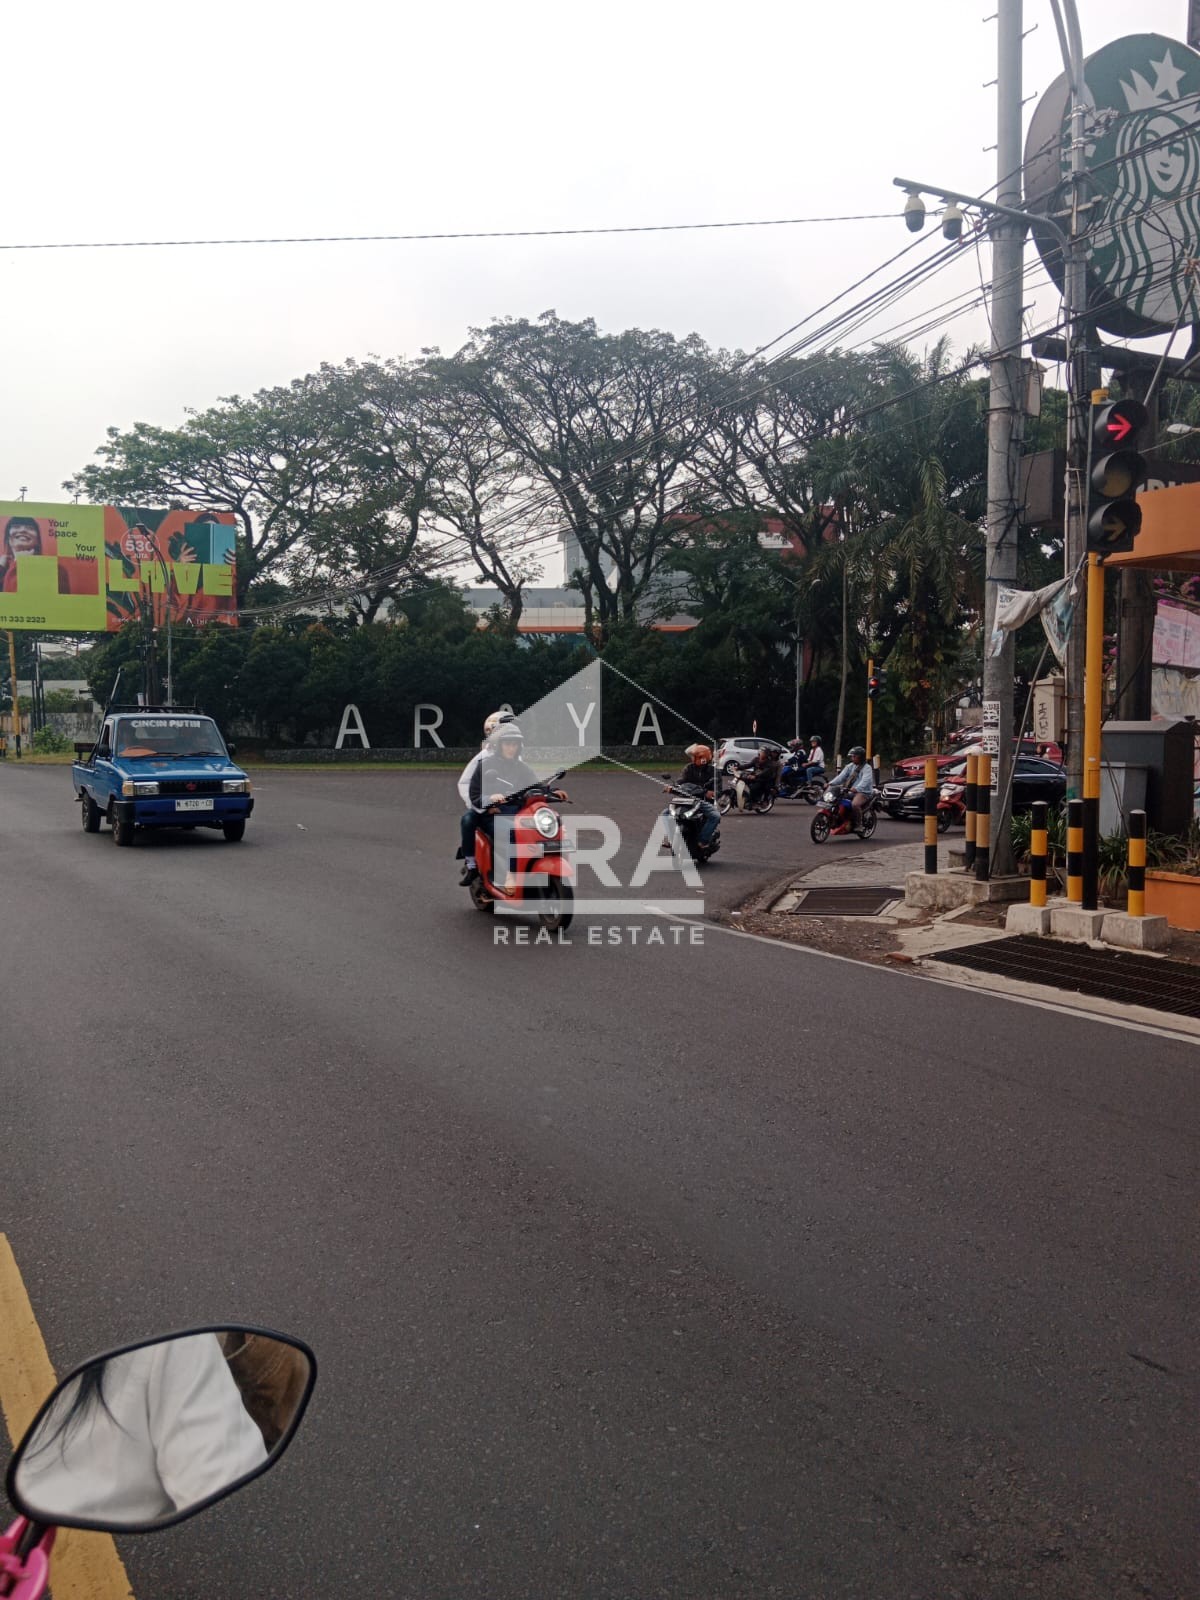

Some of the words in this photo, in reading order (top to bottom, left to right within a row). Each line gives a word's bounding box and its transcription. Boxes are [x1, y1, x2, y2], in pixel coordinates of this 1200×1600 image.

[48, 520, 69, 528] Your
[48, 529, 78, 538] Space
[75, 543, 97, 552] Your
[75, 553, 96, 563] Way
[131, 720, 167, 728] CINCIN
[335, 703, 664, 749] ARYA
